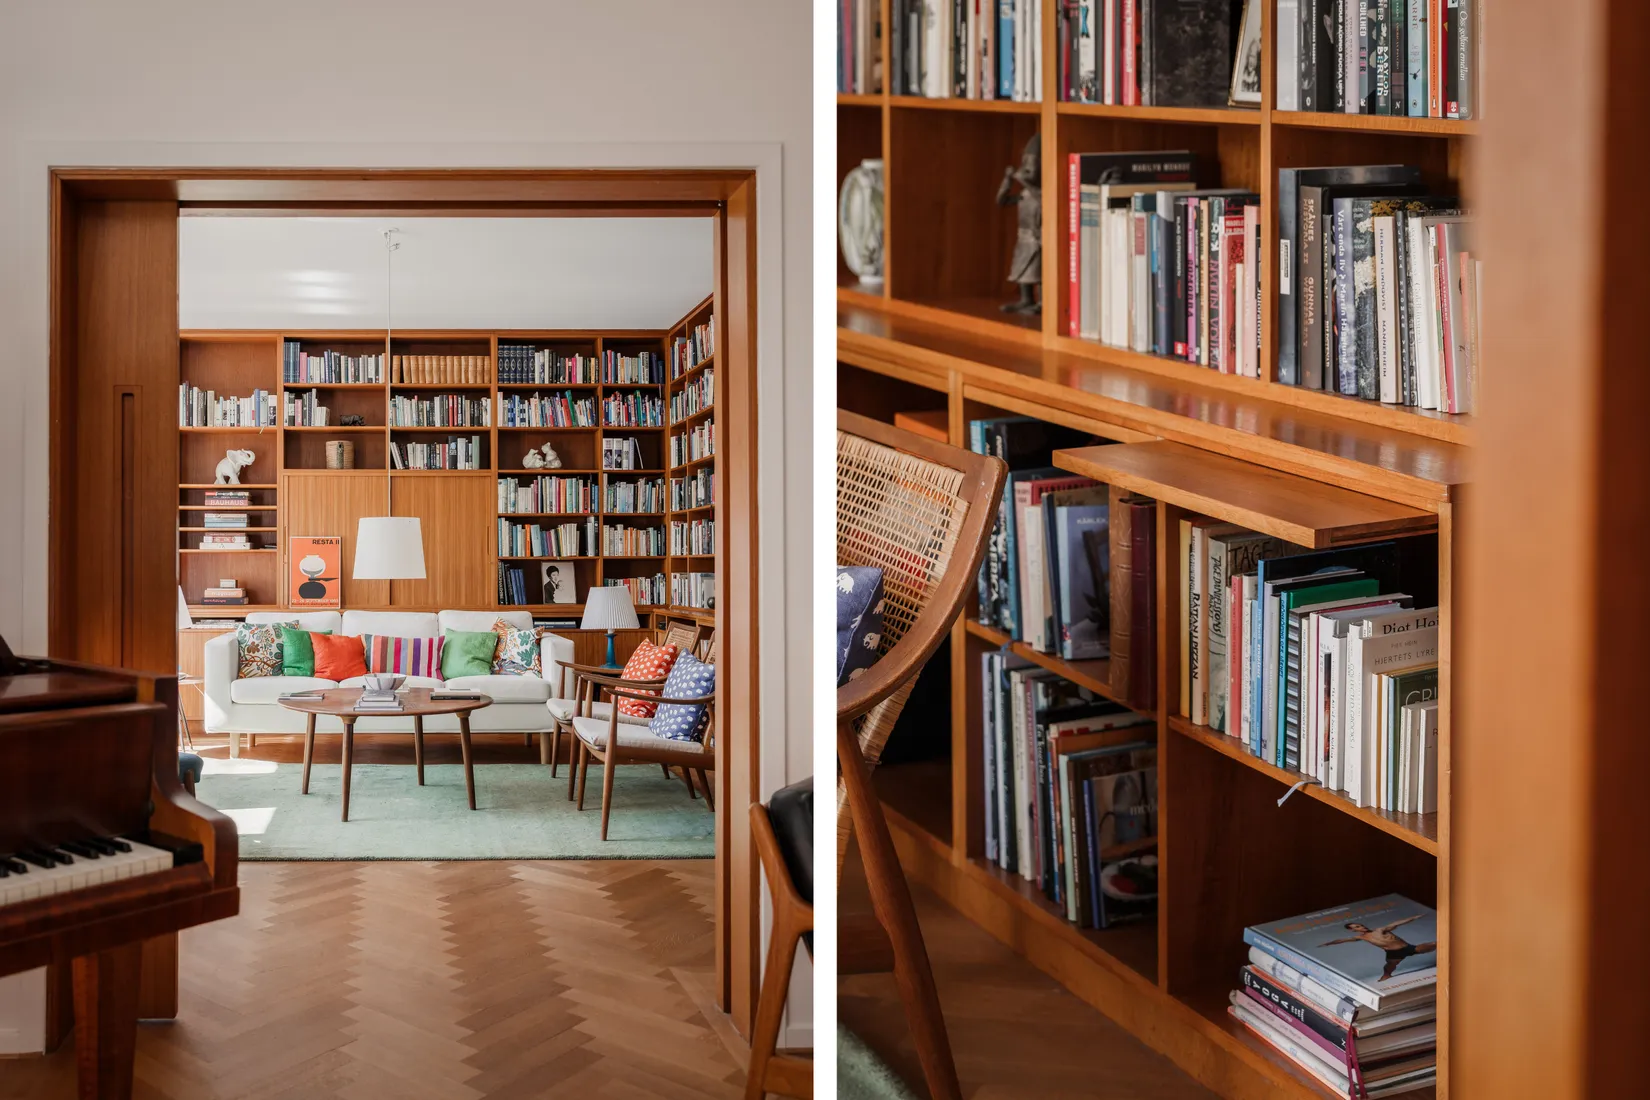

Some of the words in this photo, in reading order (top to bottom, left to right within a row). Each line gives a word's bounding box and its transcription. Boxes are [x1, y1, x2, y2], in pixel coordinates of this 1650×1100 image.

[1359, 1, 1367, 37] CULLHED
[1460, 10, 1469, 26] Oss
[1458, 27, 1469, 52] golfare
[1359, 46, 1367, 75] EUFORI
[1460, 52, 1469, 81] emellan
[1308, 199, 1316, 242] SKÅNES
[1337, 209, 1345, 231] Vårt
[1338, 233, 1346, 256] enda
[1339, 283, 1347, 315] Martin
[1211, 556, 1222, 577] TAGE
[1228, 541, 1273, 570] TAGE
[1193, 593, 1201, 632] RÅTTAN
[1213, 576, 1222, 634] DANIELSSONS
[1383, 623, 1410, 635] Piet
[1374, 653, 1412, 666] HJERTETS
[1416, 648, 1435, 658] LYRE
[1252, 979, 1290, 1011] YOGA
